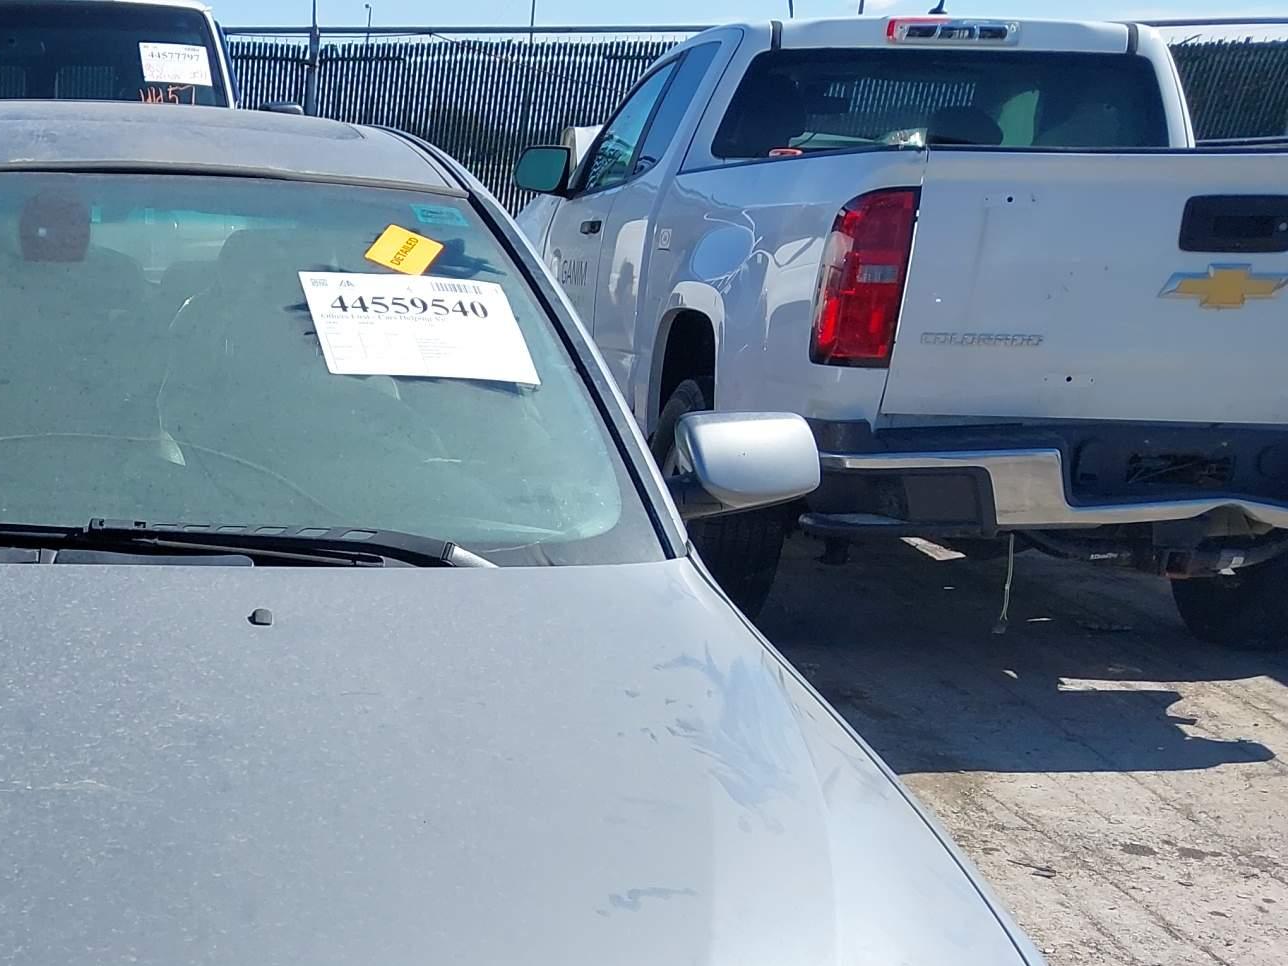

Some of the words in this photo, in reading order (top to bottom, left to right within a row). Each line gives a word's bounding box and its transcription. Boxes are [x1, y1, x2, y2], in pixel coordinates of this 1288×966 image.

[389, 237, 420, 266] DETAILED
[330, 294, 490, 319] 44559540
[920, 332, 1045, 346] COLORADO
